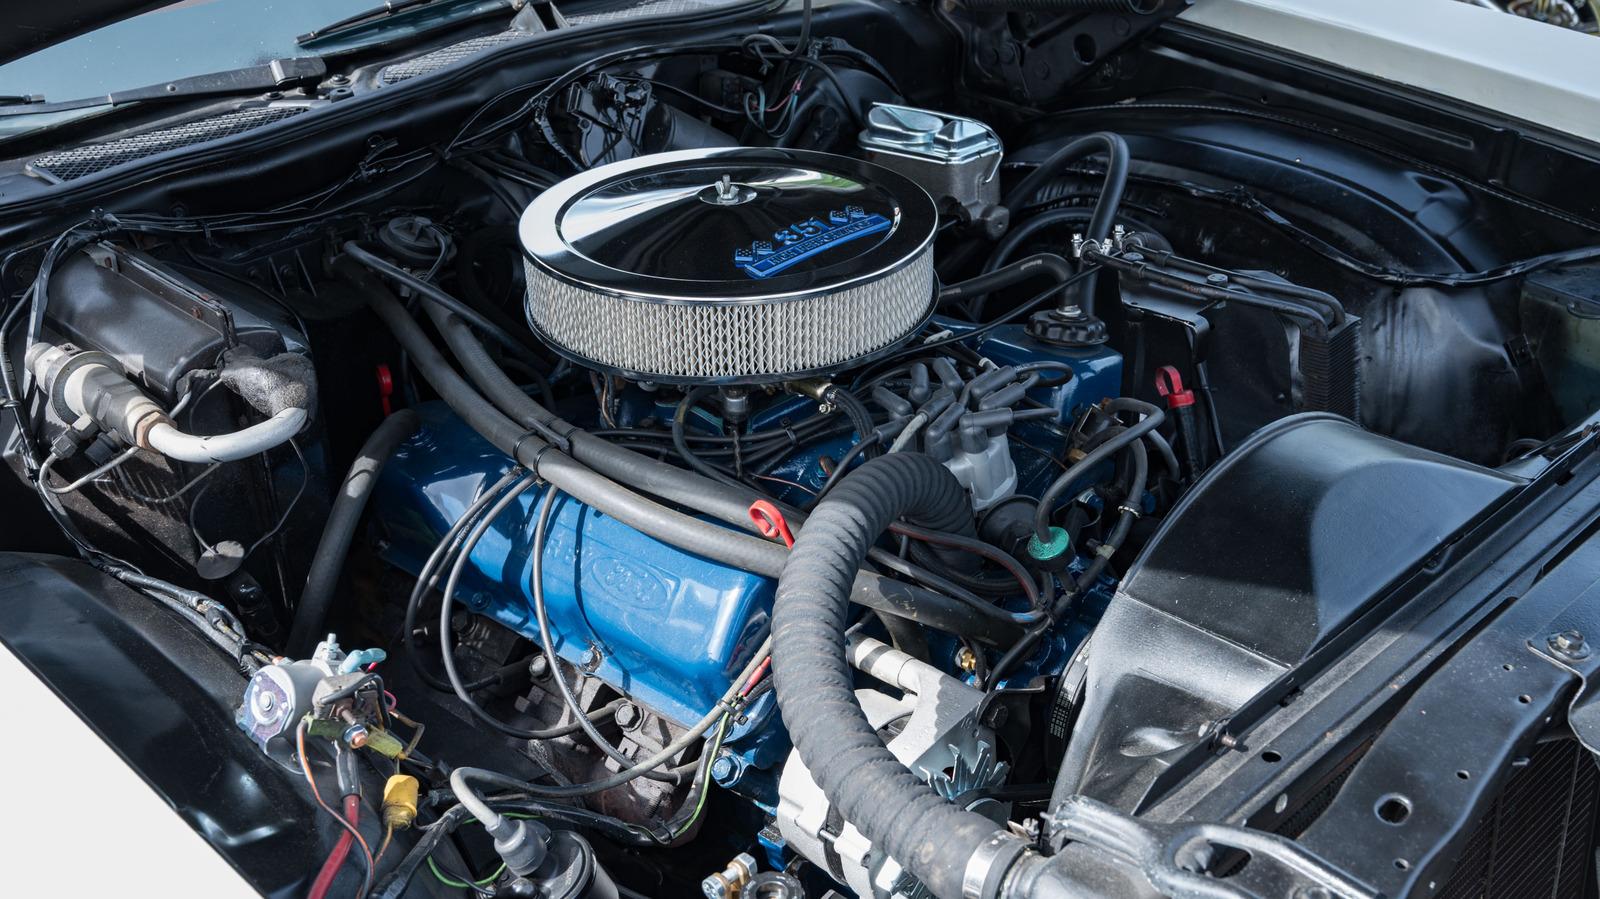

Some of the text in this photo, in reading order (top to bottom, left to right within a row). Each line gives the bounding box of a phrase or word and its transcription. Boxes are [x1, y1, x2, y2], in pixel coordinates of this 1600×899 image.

[767, 219, 875, 267] HIGH PERFORMANCE
[774, 217, 835, 246] 351
